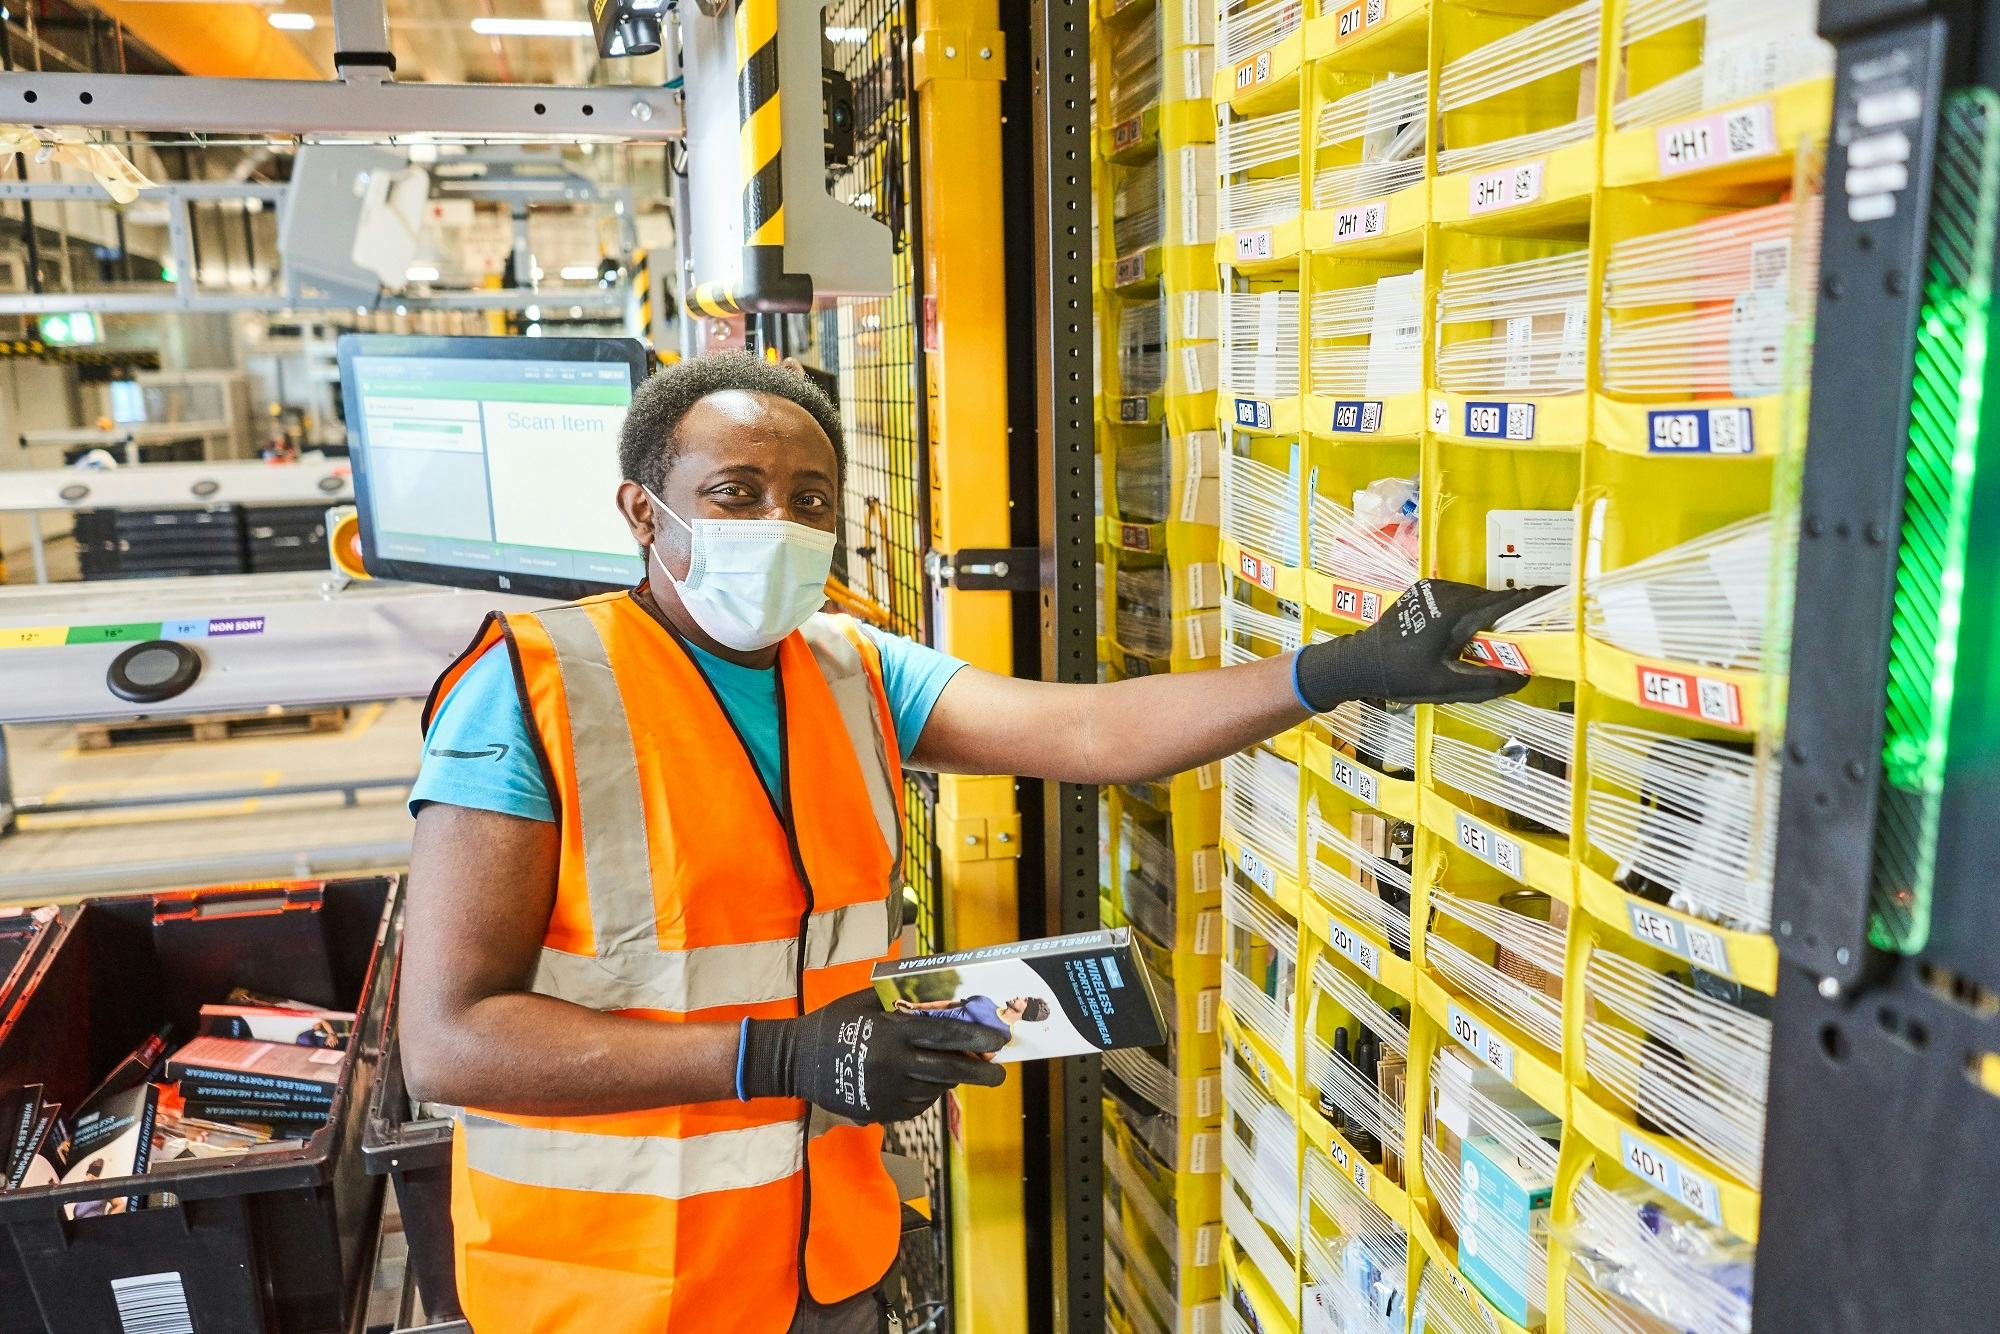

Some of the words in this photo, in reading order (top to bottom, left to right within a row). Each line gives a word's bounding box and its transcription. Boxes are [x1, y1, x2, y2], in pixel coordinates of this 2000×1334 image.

[1669, 130, 1698, 160] 4H
[1477, 180, 1495, 205] 3H
[1338, 214, 1352, 236] 2H
[1239, 238, 1249, 255] 1H
[507, 411, 555, 430] Scan
[562, 414, 604, 433] Item
[1240, 405, 1249, 421] 1G
[1338, 407, 1351, 427] 2G
[1471, 409, 1489, 432] 3G
[1656, 416, 1683, 446] 4G
[1337, 591, 1350, 611] 2F
[209, 620, 234, 633] NON
[235, 619, 263, 632] SORT
[1646, 673, 1671, 701] 4F
[1335, 762, 1347, 784] 2E
[1462, 824, 1480, 851] 3E
[1334, 927, 1346, 949] 2D
[1638, 913, 1664, 941] 4E
[976, 942, 1028, 959] SPORTS
[1032, 934, 1102, 952] WIRELESS
[898, 951, 973, 970] HEADWEAR
[1085, 958, 1115, 1015] WIRELESS
[1073, 959, 1093, 996] SPORTS
[1087, 997, 1112, 1045] HEADWEAR
[1455, 1015, 1472, 1042] 3D
[185, 1067, 238, 1083] HEADWEAR
[239, 1074, 274, 1087] SPORTS
[197, 1086, 251, 1099] HEADWEAR
[253, 1090, 290, 1101] SPORTS
[276, 1079, 322, 1094] WIRELESS
[205, 1106, 260, 1117] HEADWEAR
[261, 1108, 299, 1119] SPORTS
[17, 1103, 33, 1147] WIRELESS
[141, 1103, 155, 1154] HEADWEAR
[1331, 1140, 1343, 1164] 2C
[1631, 1147, 1655, 1177] 4D
